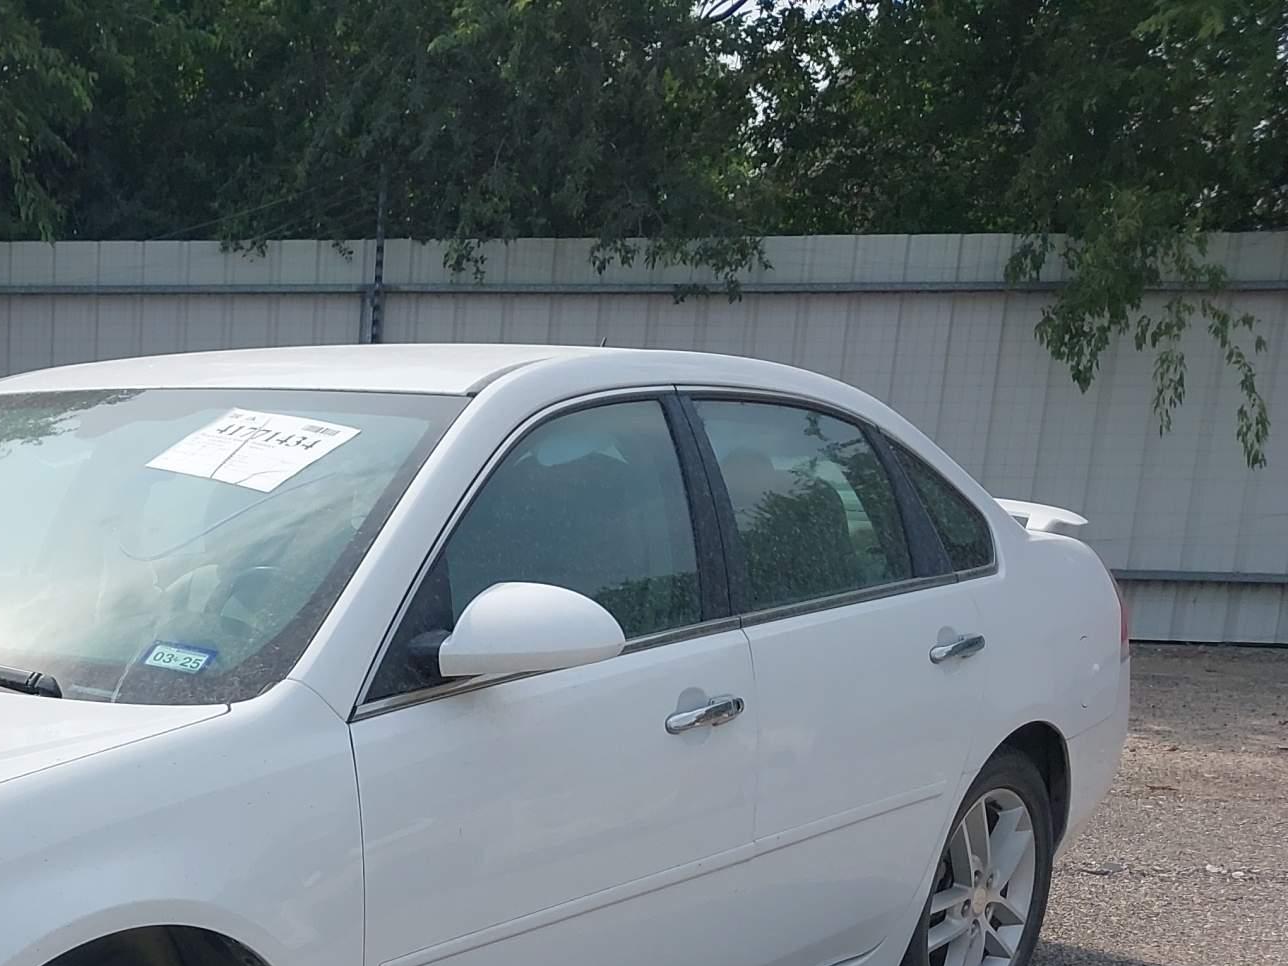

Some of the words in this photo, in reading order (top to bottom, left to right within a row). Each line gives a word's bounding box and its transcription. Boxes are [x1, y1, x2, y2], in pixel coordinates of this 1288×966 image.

[216, 423, 322, 450] 41771434
[152, 651, 175, 664] 03
[179, 656, 203, 669] 25
